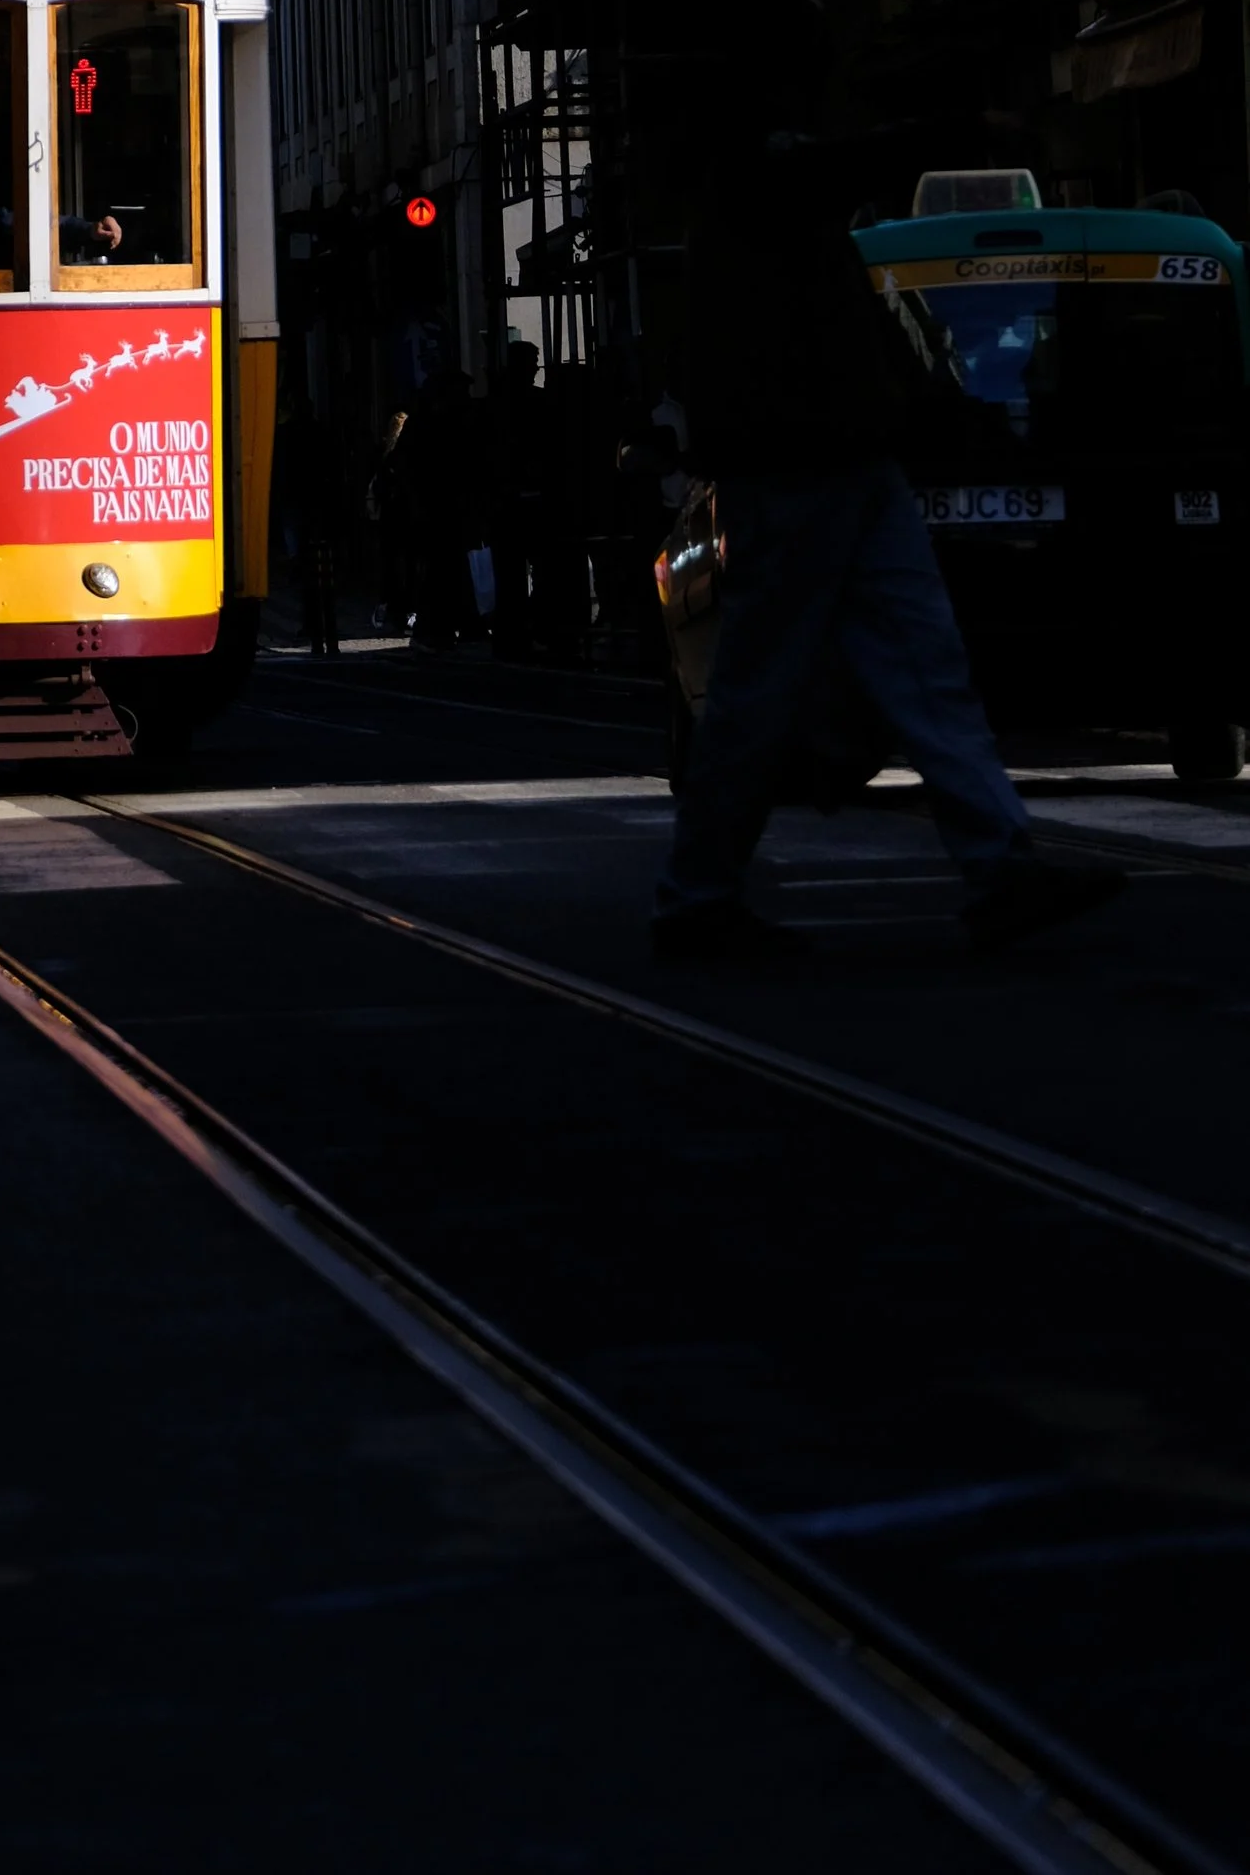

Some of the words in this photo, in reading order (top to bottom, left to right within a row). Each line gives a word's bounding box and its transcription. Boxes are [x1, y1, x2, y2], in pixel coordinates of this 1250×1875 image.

[1162, 258, 1219, 280] 658
[110, 421, 133, 454] O
[137, 420, 208, 453] MUNDO
[23, 457, 131, 491] PRECISA
[134, 456, 163, 487] DE
[166, 454, 209, 486] MAIS
[93, 490, 141, 523] PAIS
[144, 488, 209, 521] NATAIS
[957, 488, 997, 519] JC
[1005, 487, 1043, 518] 69
[1181, 491, 1212, 507] 902
